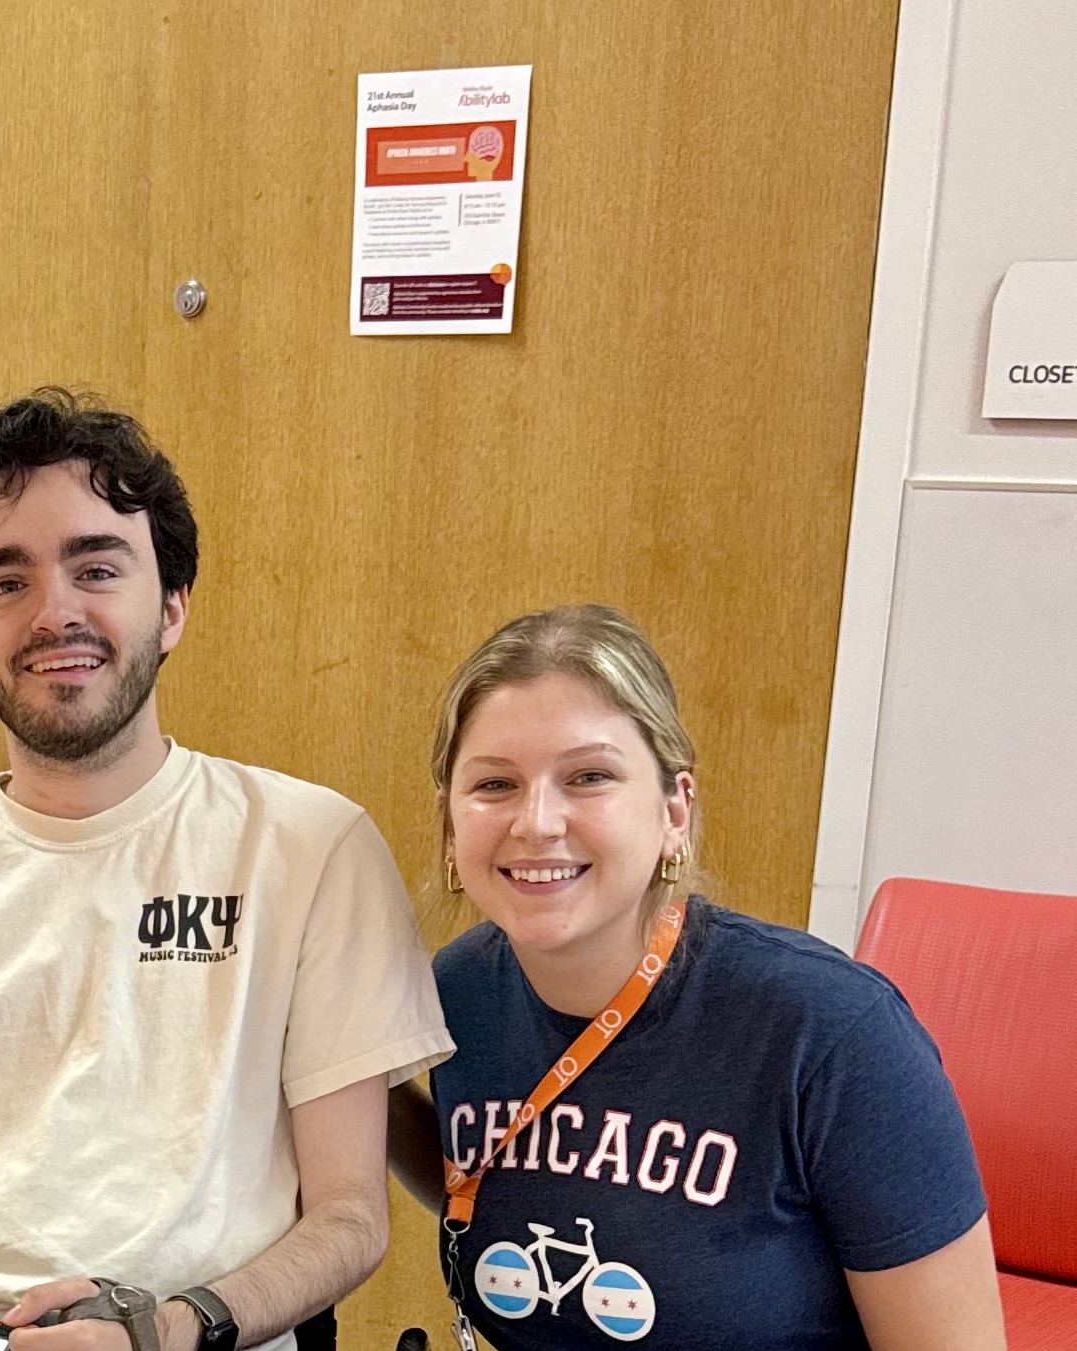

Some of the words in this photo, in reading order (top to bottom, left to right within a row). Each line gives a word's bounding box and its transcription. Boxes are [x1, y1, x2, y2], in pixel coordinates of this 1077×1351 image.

[400, 101, 417, 112] Day
[139, 950, 175, 963] MUSIC
[177, 950, 227, 963] FESTIVAL
[449, 1099, 738, 1208] CHICAGO
